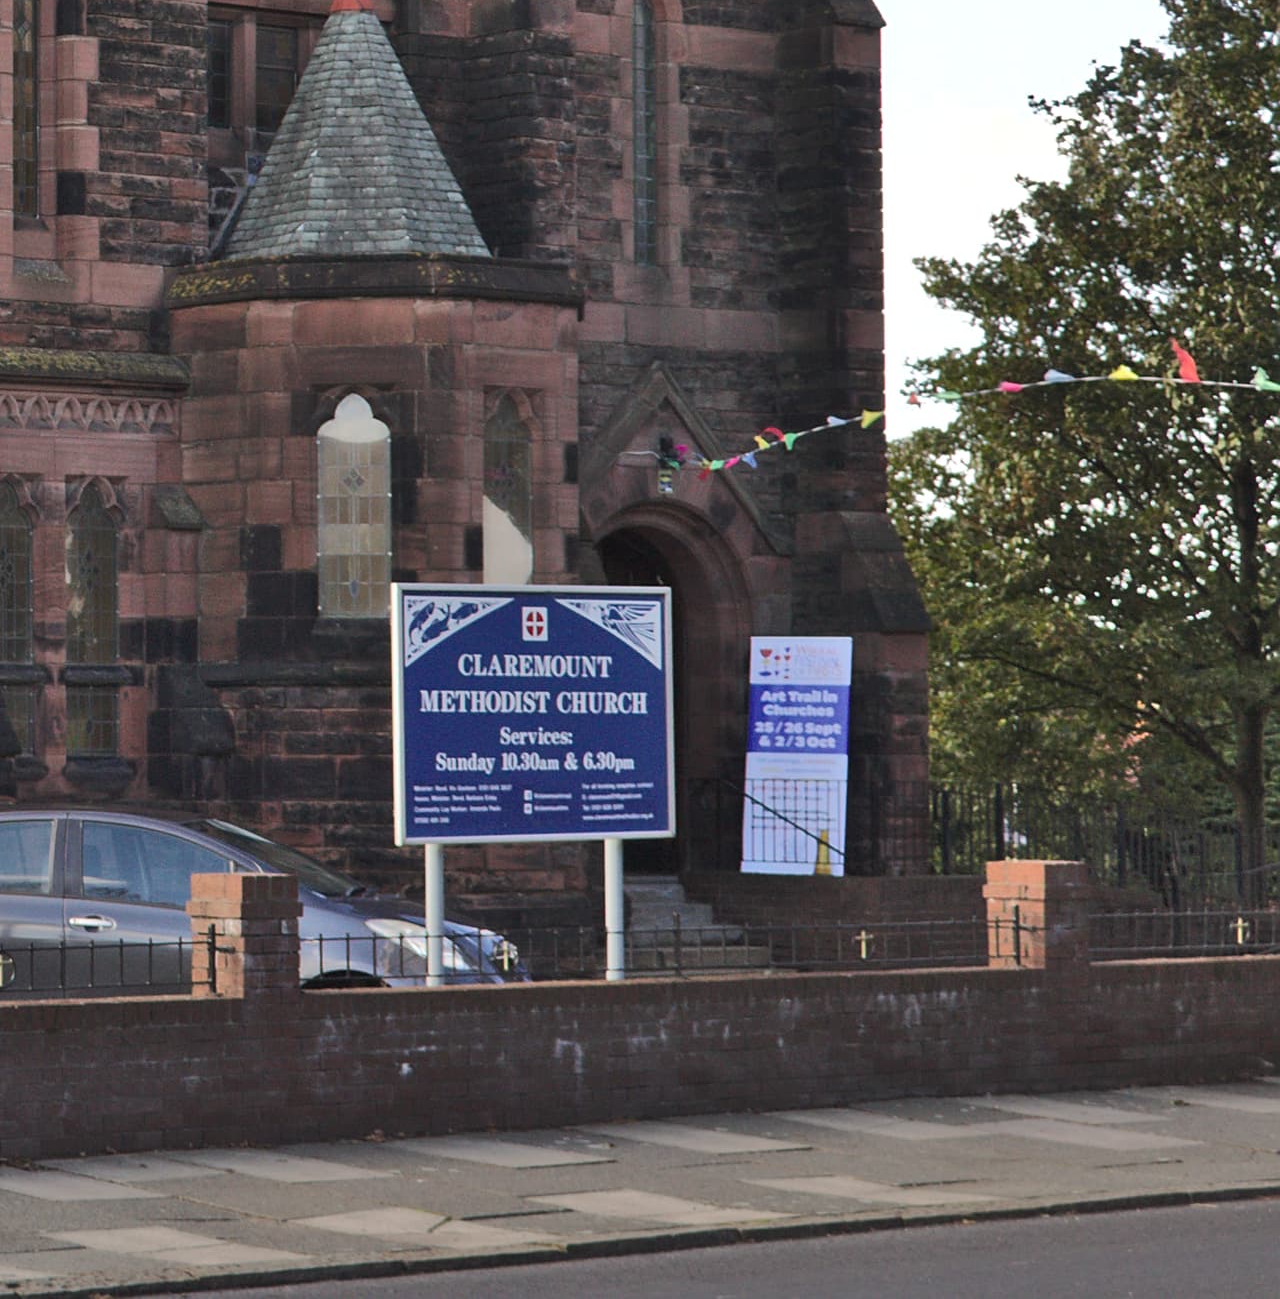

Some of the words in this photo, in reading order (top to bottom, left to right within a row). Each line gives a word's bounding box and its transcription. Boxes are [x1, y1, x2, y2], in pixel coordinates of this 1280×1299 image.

[458, 653, 612, 678] CLAREMOUNT
[419, 690, 550, 713] METHODIST
[556, 692, 648, 714] CHURCH
[761, 690, 786, 702] Art
[787, 690, 821, 703] Trail
[822, 690, 838, 703] in
[762, 704, 835, 717] Churches
[500, 727, 573, 745] Services:
[805, 722, 842, 737] Sept
[758, 735, 771, 747] &
[806, 736, 836, 748] Oct
[435, 752, 495, 774] Sunday
[501, 753, 560, 771] 10.30am
[563, 752, 578, 771] &
[583, 752, 635, 773] 6.30pm
